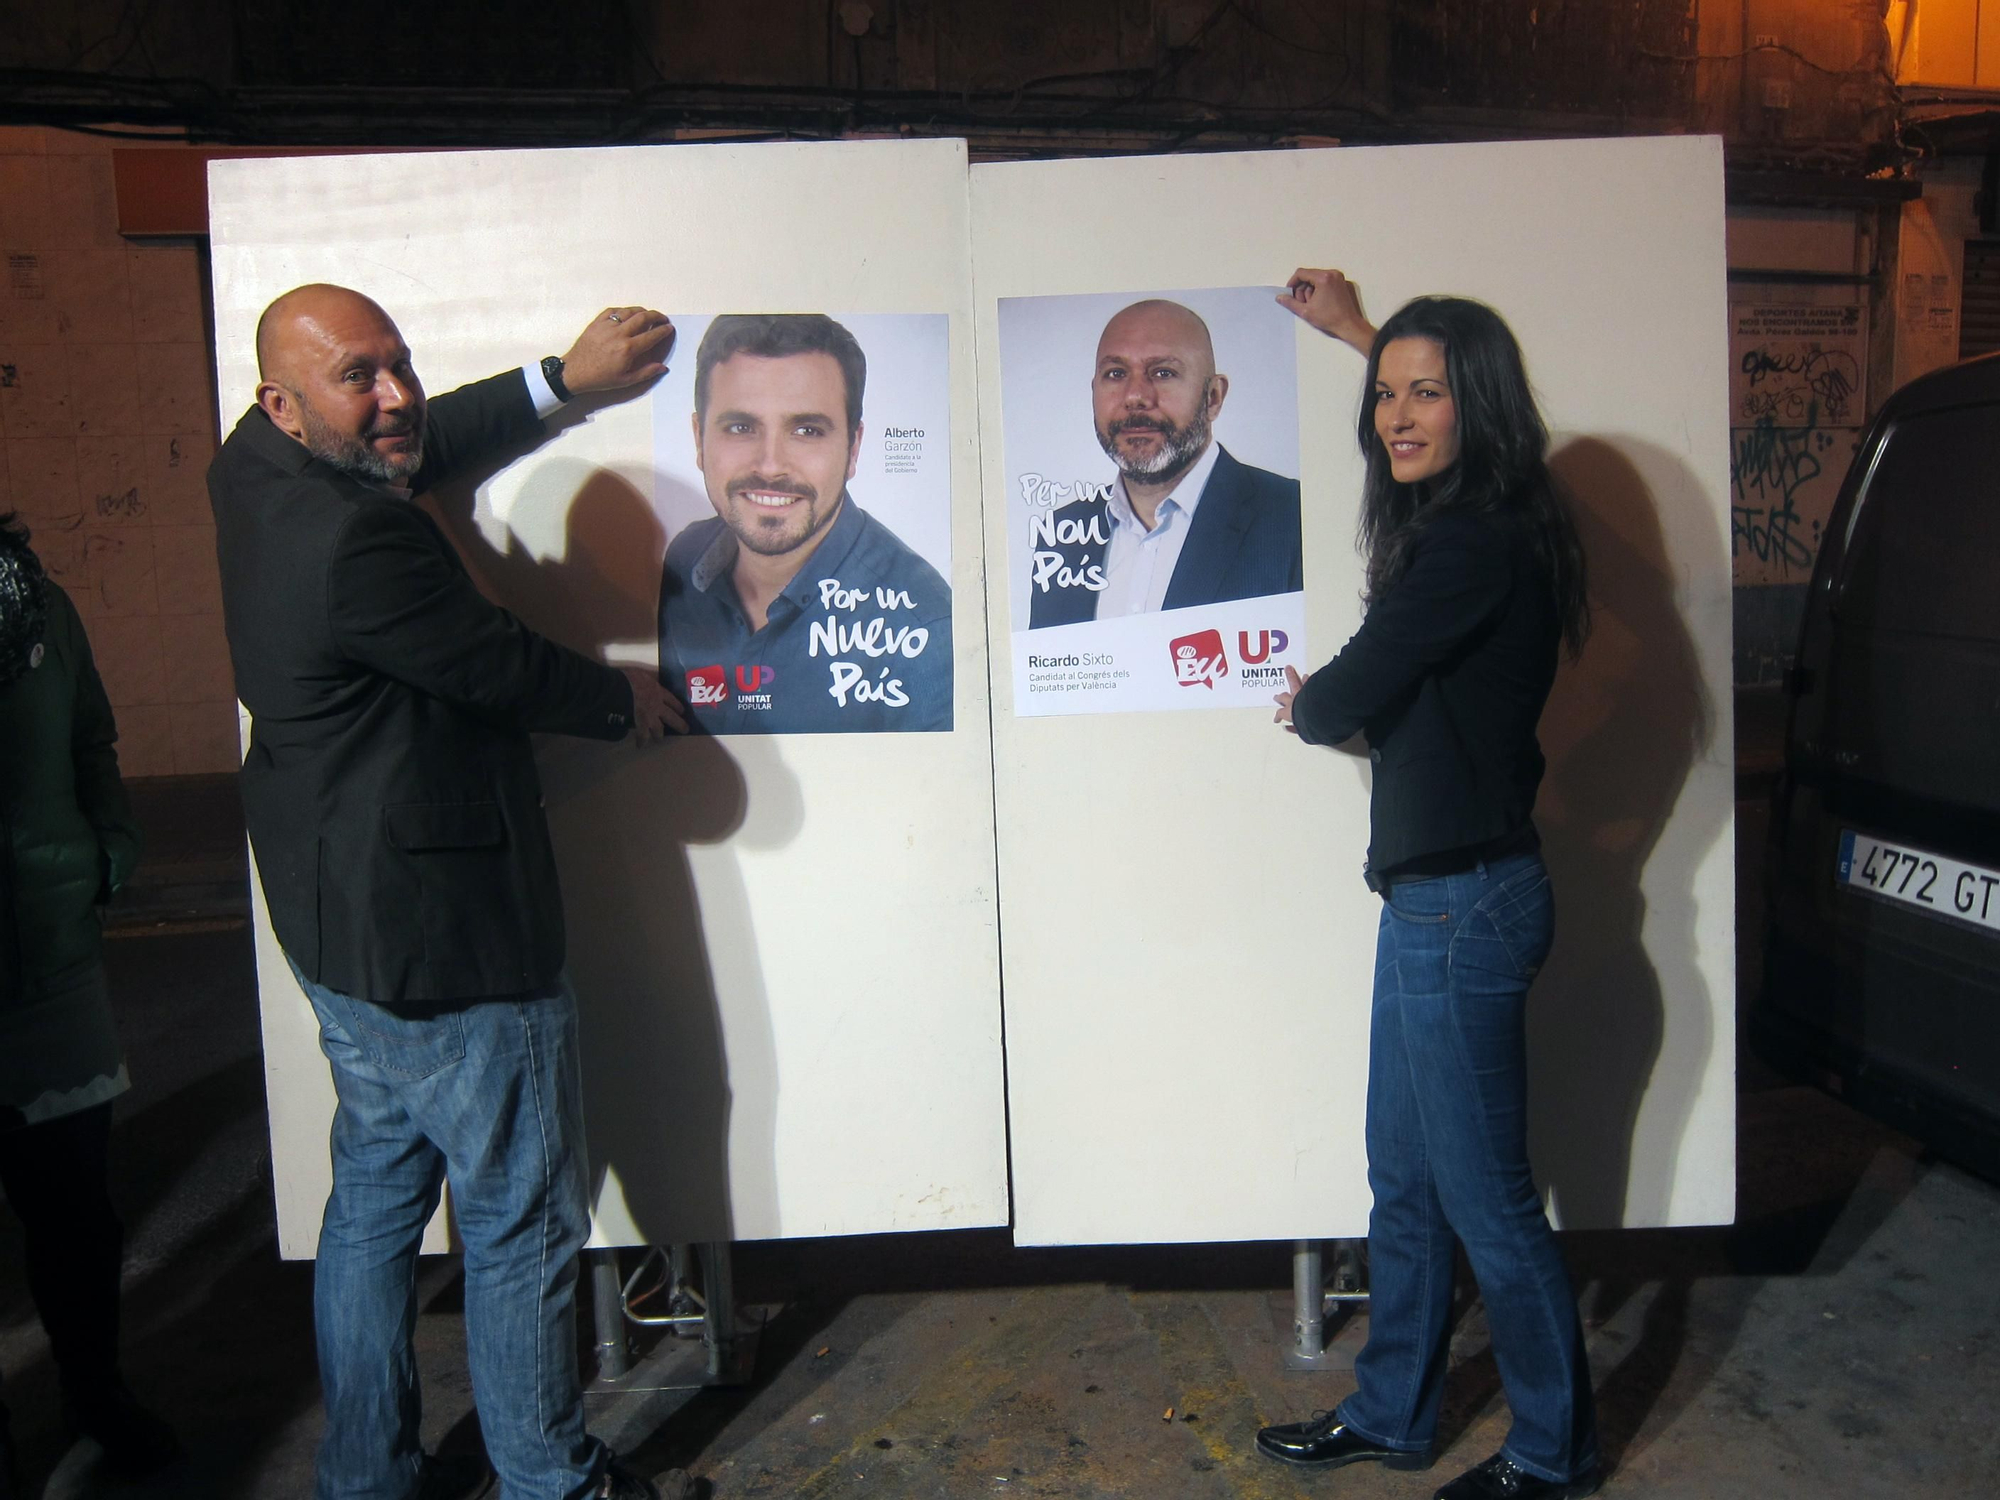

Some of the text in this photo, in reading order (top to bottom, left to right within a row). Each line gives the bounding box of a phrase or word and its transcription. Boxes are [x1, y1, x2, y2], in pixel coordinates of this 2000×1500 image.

[1753, 308, 1806, 317] DEPORTES
[1762, 318, 1838, 326] ENCONTRAMOS
[884, 427, 925, 438] Alberto
[884, 440, 922, 451] Garzón
[1018, 473, 1115, 507] Per un
[1028, 509, 1110, 549] Nou
[1033, 551, 1110, 593] País
[817, 578, 918, 612] Por un
[808, 615, 930, 659] Nuevo
[1028, 652, 1114, 668] Ricardo Sixto
[1029, 669, 1130, 682] Candidat al Congrés dels
[1241, 667, 1284, 679] UNITAT
[828, 661, 910, 708] País
[1029, 681, 1117, 693] Diputats per València
[1241, 677, 1286, 688] POPULAR
[737, 694, 772, 703] UNITAT
[1841, 861, 1848, 873] E
[1861, 845, 2000, 919] 4772 GT
